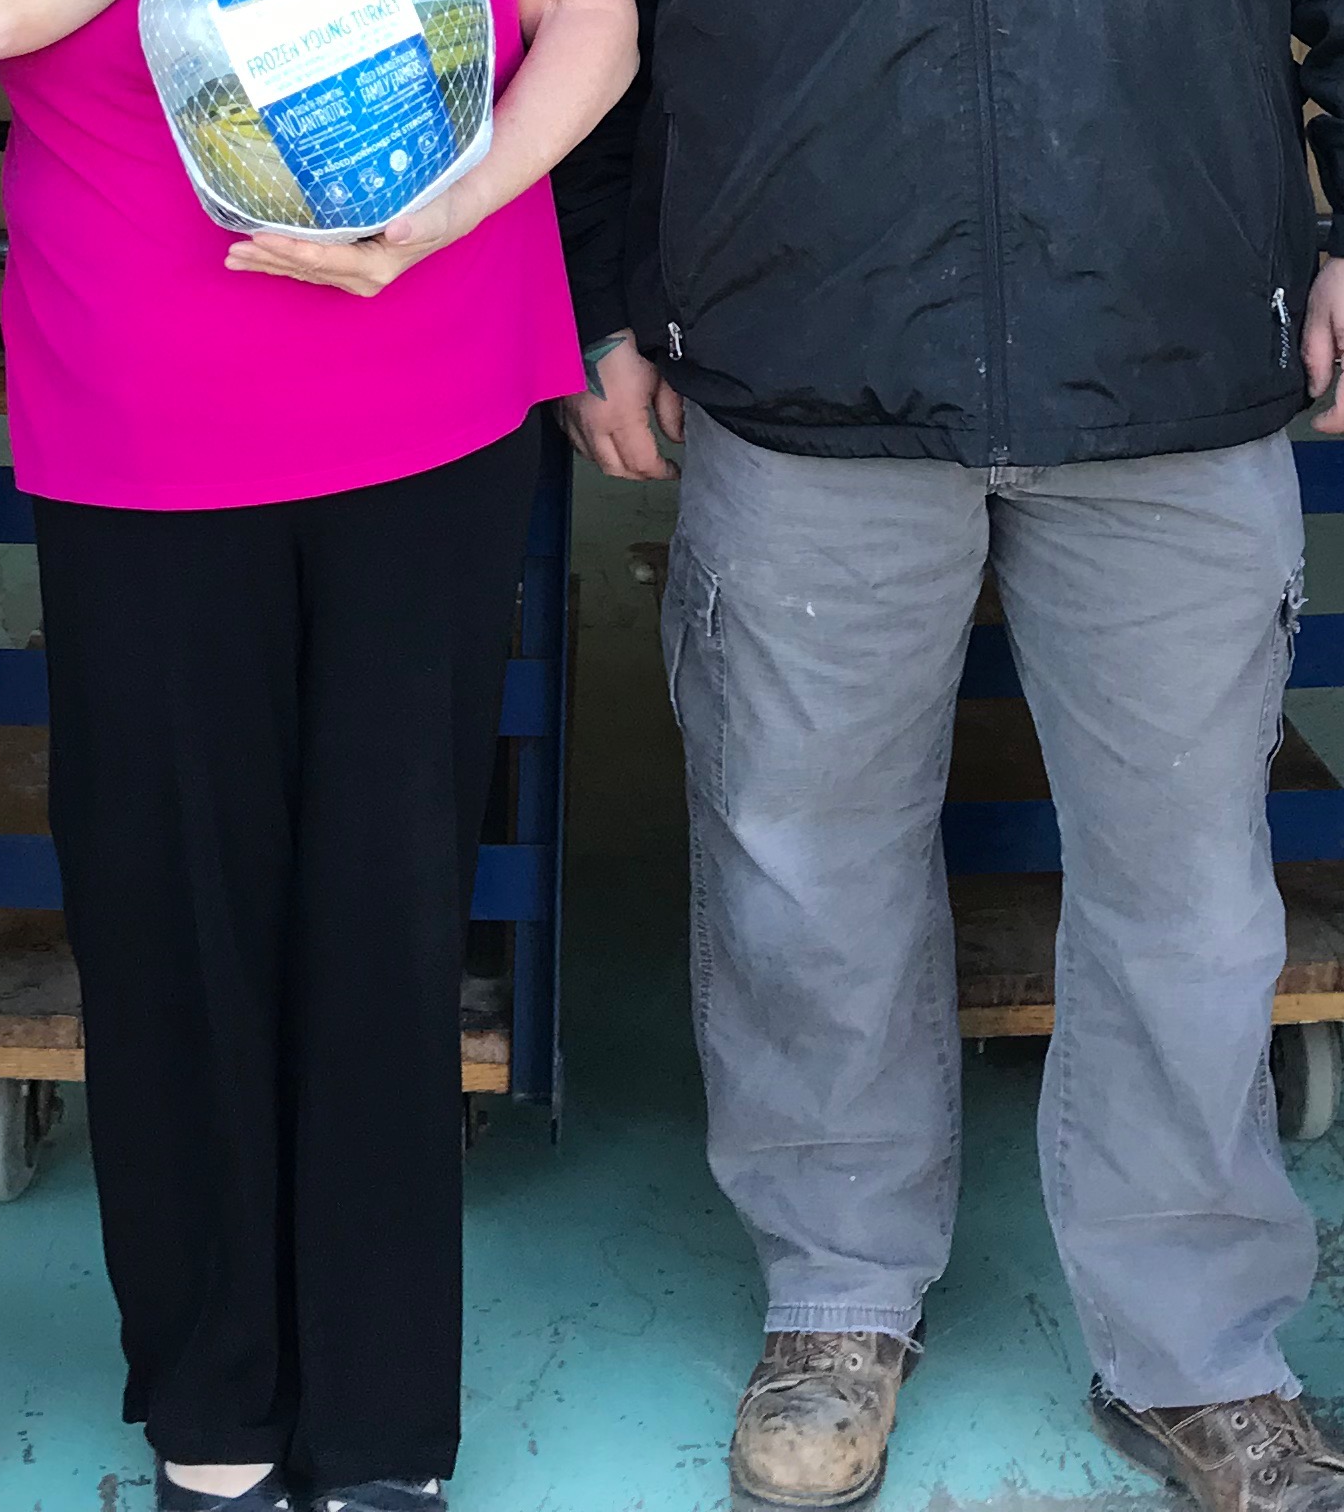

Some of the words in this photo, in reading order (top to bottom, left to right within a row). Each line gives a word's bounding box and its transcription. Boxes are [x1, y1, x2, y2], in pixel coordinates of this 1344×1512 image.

[246, 41, 300, 79] FROZEN
[299, 16, 351, 52] YOUNG
[359, 77, 391, 105] FAMILY
[390, 59, 425, 88] FARMERS
[274, 108, 305, 139] NO
[300, 96, 353, 133] ANTIBIOTICS
[325, 158, 351, 174] ADDED
[351, 137, 391, 165] HORMONES
[391, 130, 402, 140] OR
